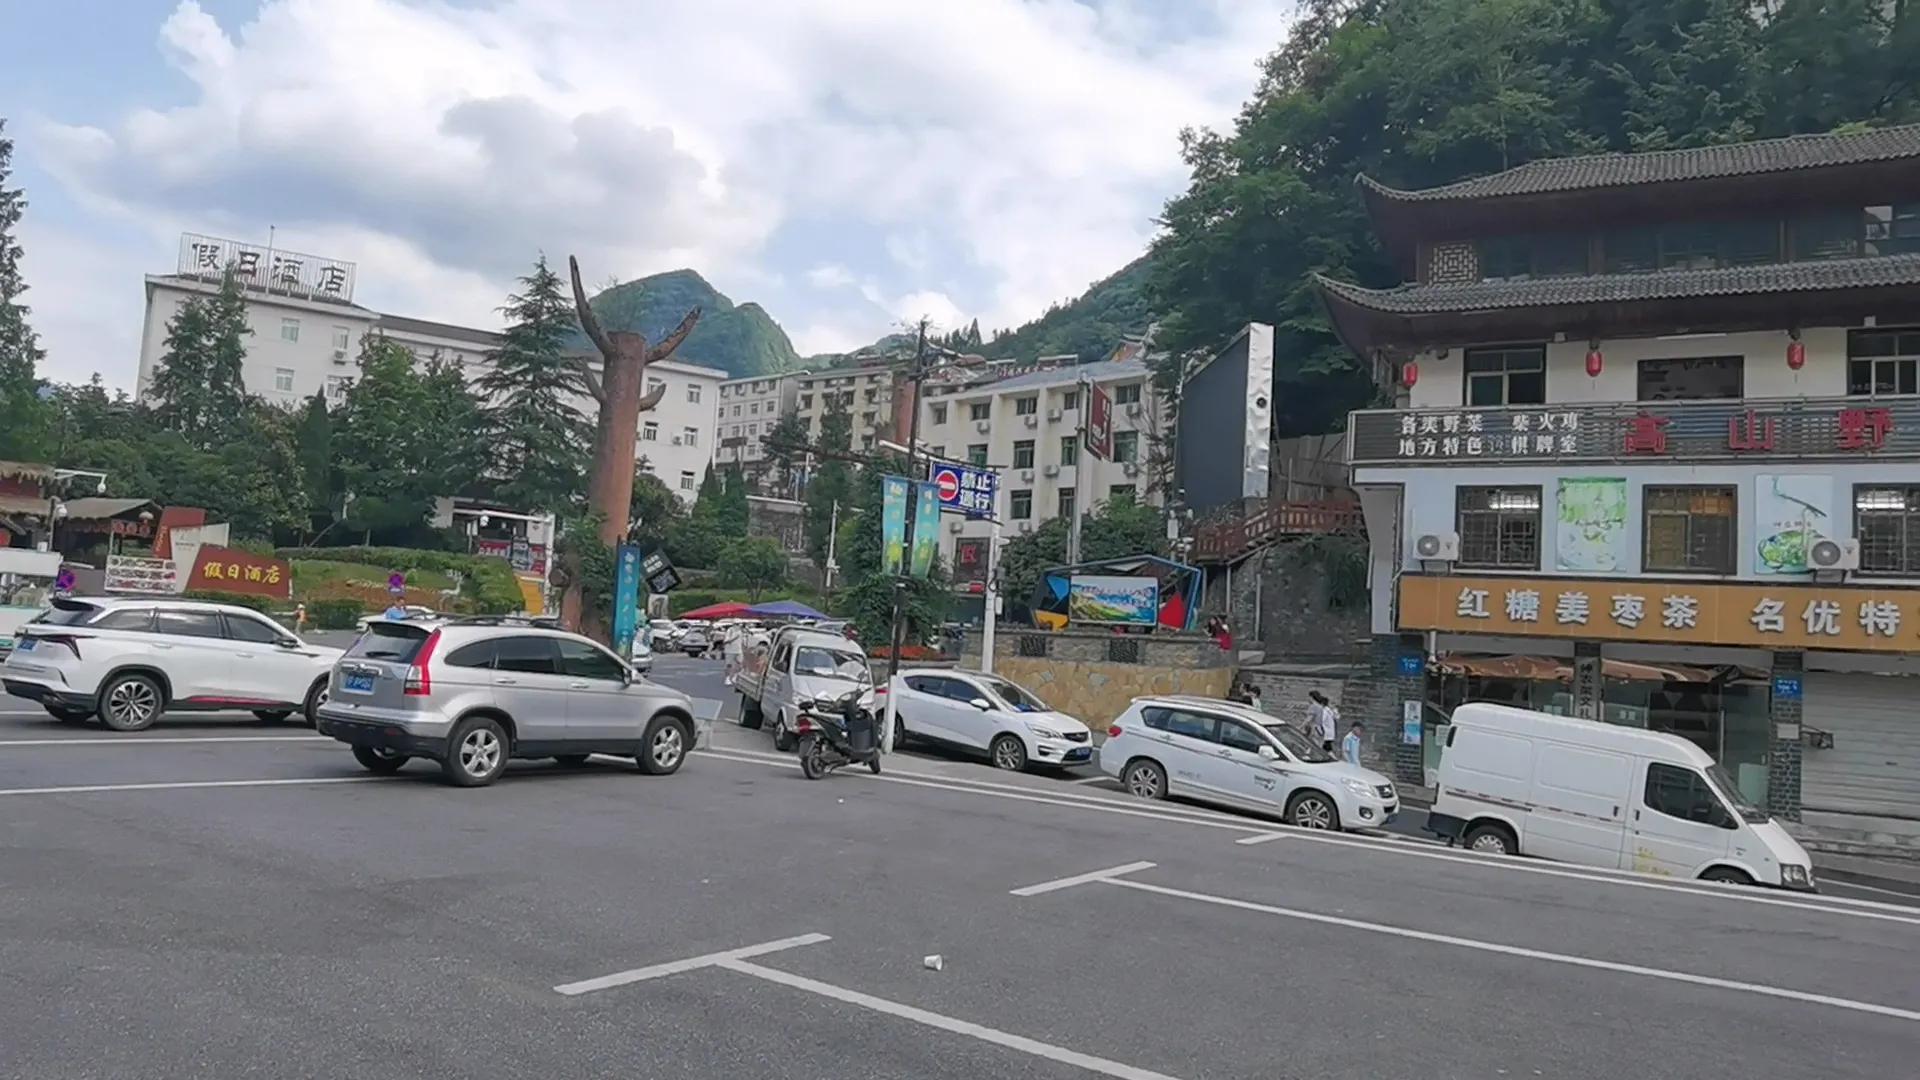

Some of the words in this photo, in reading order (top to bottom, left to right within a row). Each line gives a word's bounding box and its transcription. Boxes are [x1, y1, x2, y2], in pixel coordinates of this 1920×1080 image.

[192, 243, 346, 293] 假日酒店
[1624, 408, 1893, 455] 高山野
[1399, 436, 1483, 456] 地方特色
[1511, 434, 1577, 455] 棋牌室
[960, 471, 992, 492] 禁止
[958, 489, 990, 511] 通行
[204, 561, 282, 584] 假日酒店
[1458, 586, 1699, 629] 红糖姜枣茶
[1751, 598, 1901, 637] 名优特
